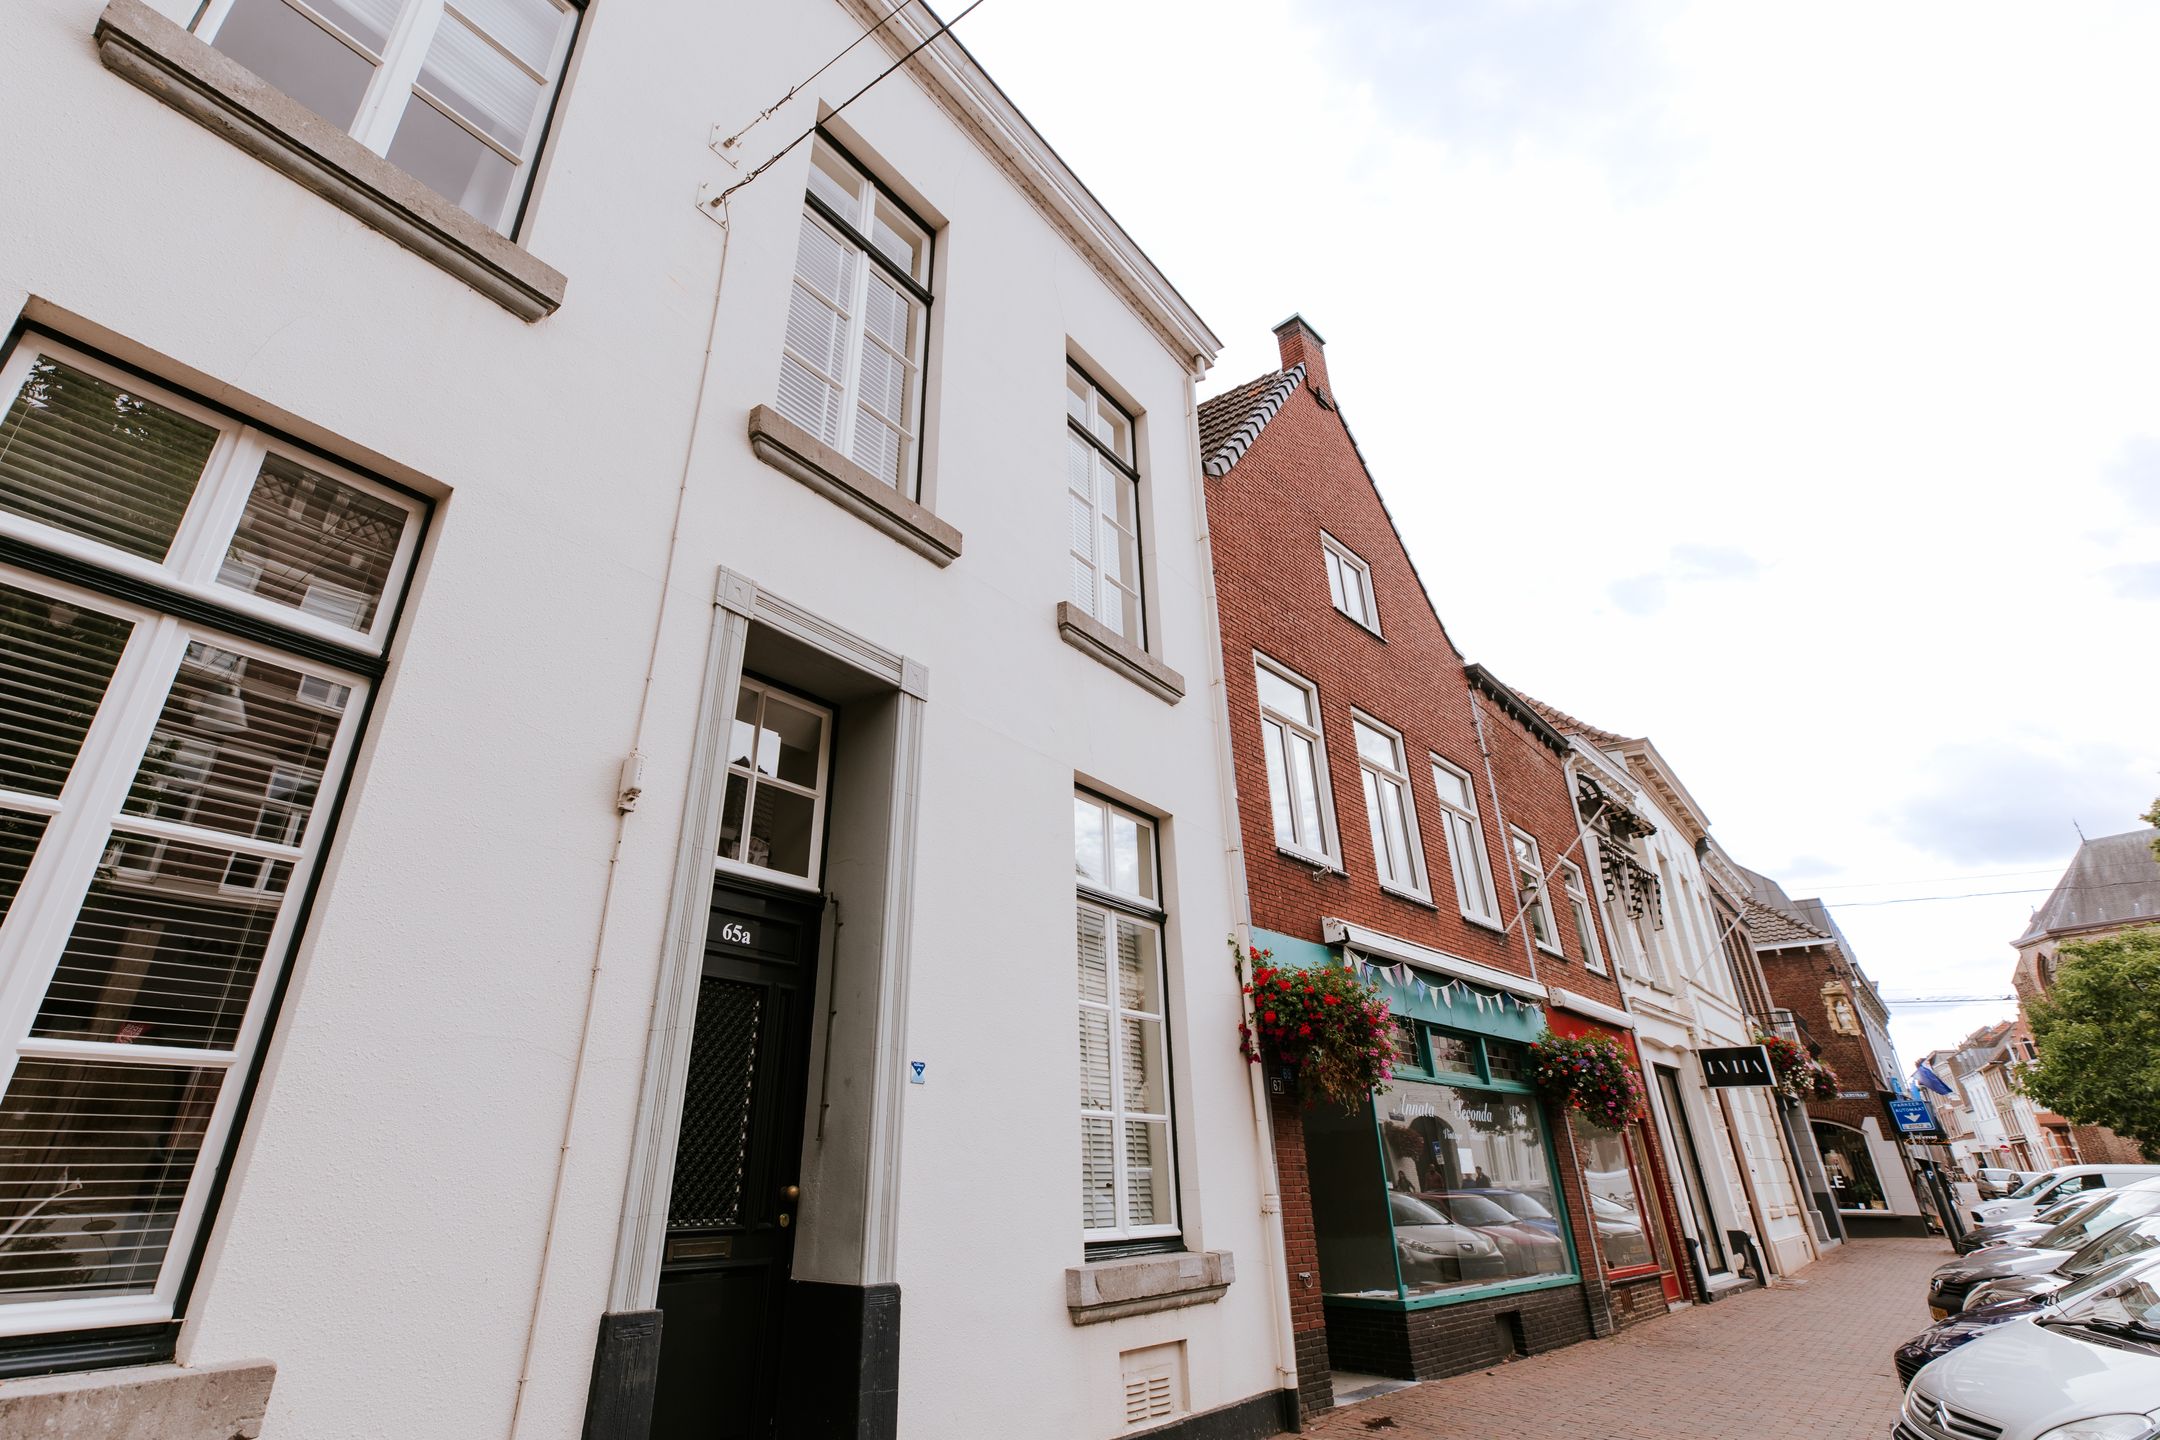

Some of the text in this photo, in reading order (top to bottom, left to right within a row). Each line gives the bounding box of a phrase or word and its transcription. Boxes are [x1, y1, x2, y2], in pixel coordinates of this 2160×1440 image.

[722, 922, 751, 945] 65a
[1272, 1079, 1282, 1092] 67
[1392, 1092, 1435, 1118] Annata
[1454, 1099, 1493, 1123] Seconda
[1926, 1170, 1934, 1180] P
